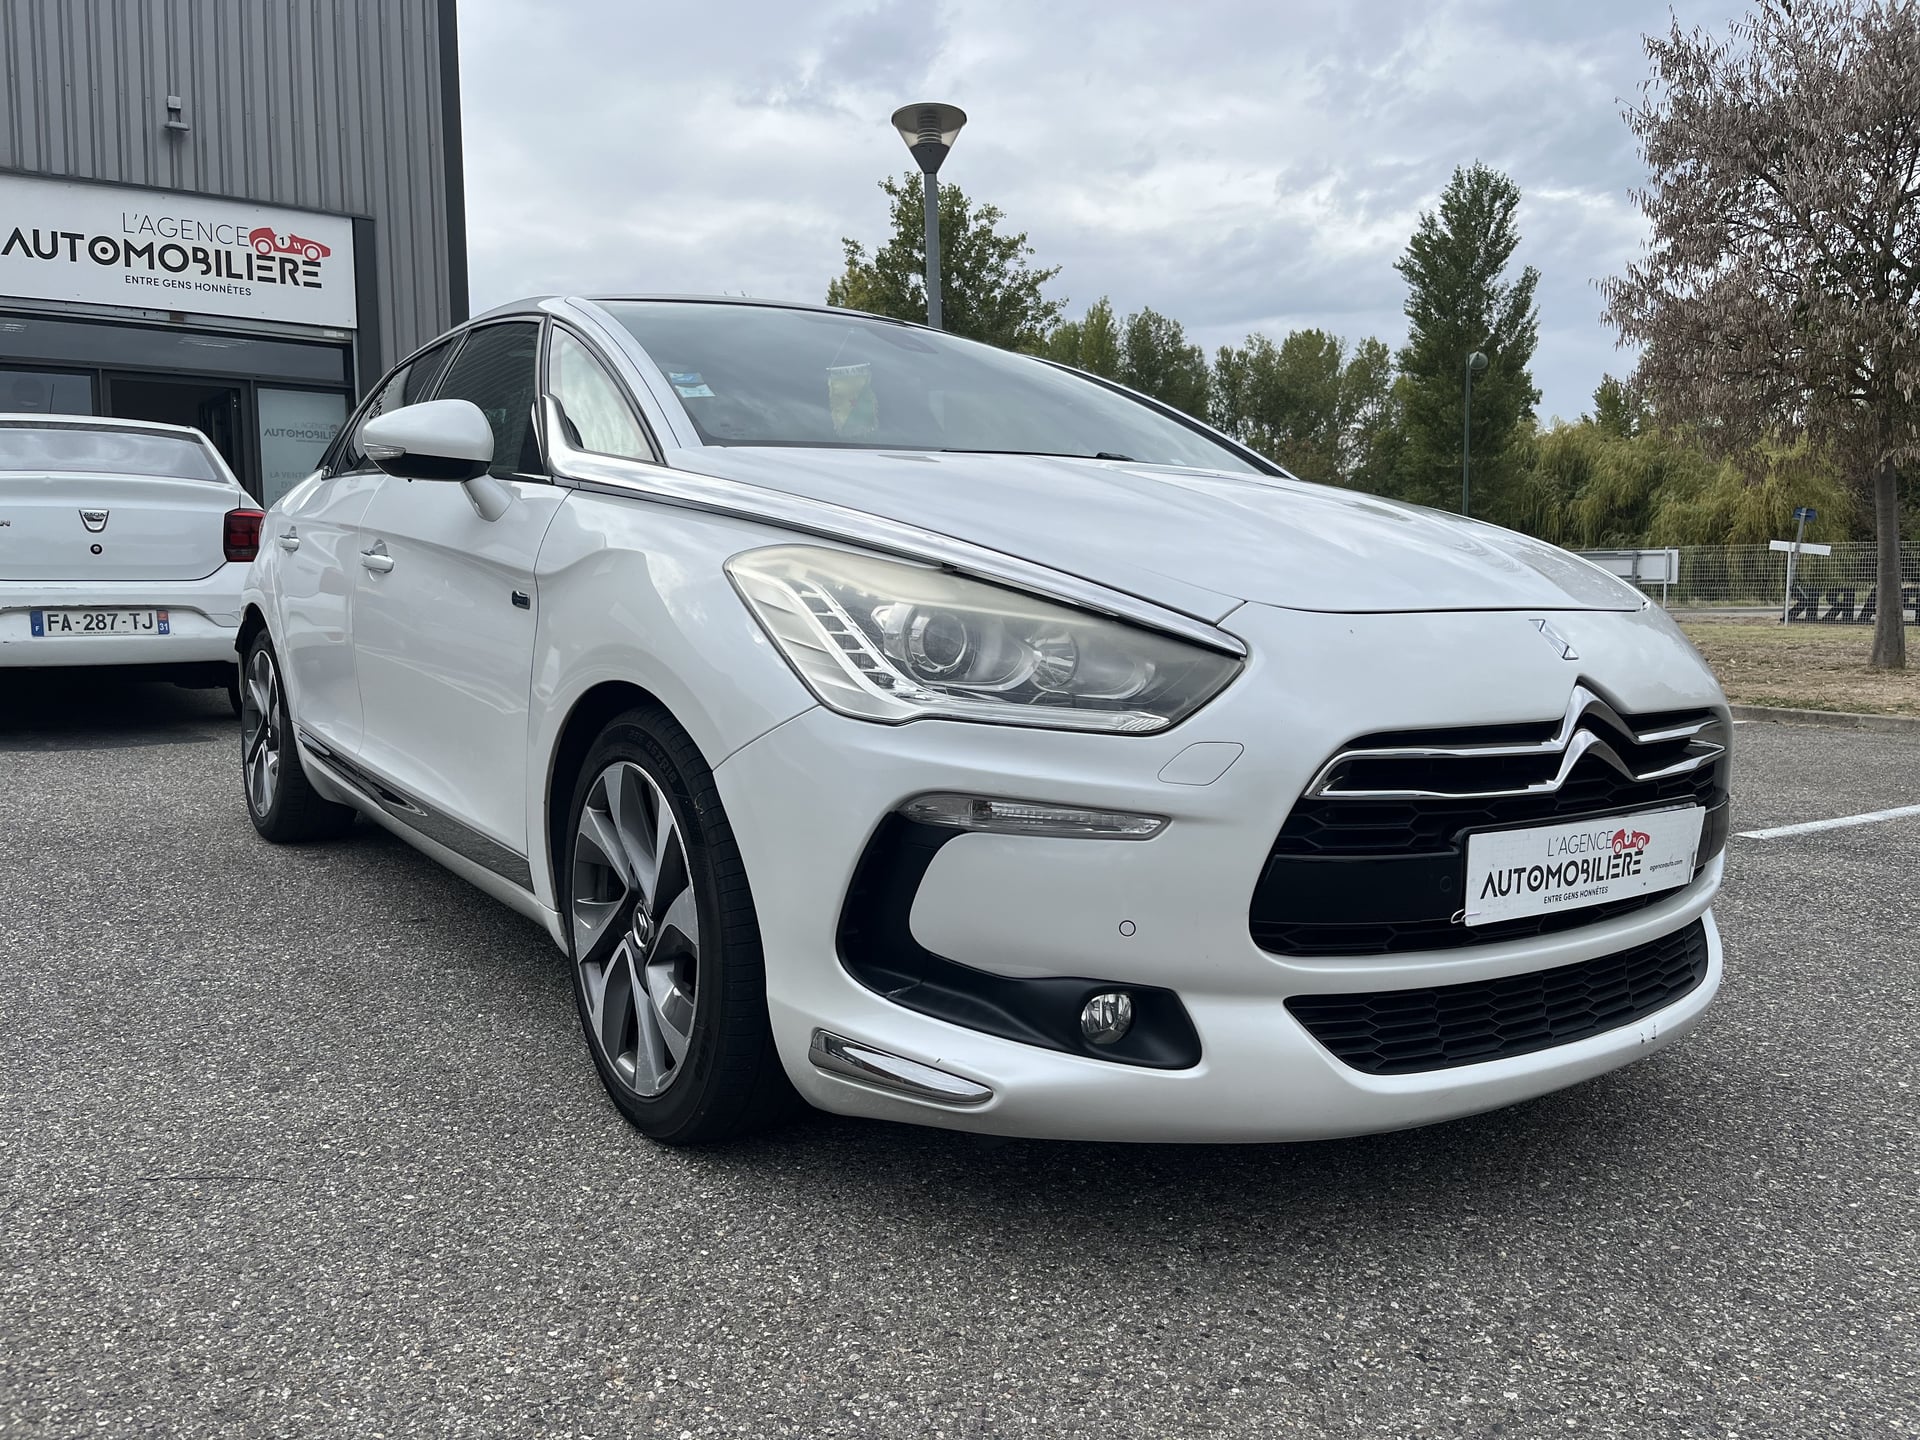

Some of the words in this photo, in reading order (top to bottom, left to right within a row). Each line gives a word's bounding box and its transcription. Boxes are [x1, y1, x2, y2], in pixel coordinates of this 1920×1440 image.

[122, 212, 250, 247] L'AGENCE
[279, 236, 285, 246] 1
[125, 275, 160, 287] ENTRE
[163, 278, 192, 290] GENS
[195, 282, 252, 296] HONNÊTES
[47, 613, 153, 631] FA-287-TJ
[159, 623, 169, 631] 31
[1547, 830, 1613, 856] L'AGENCE
[1544, 894, 1562, 904] ENTRE
[1563, 891, 1579, 901] GENS
[1579, 885, 1609, 898] HONNÊTES
